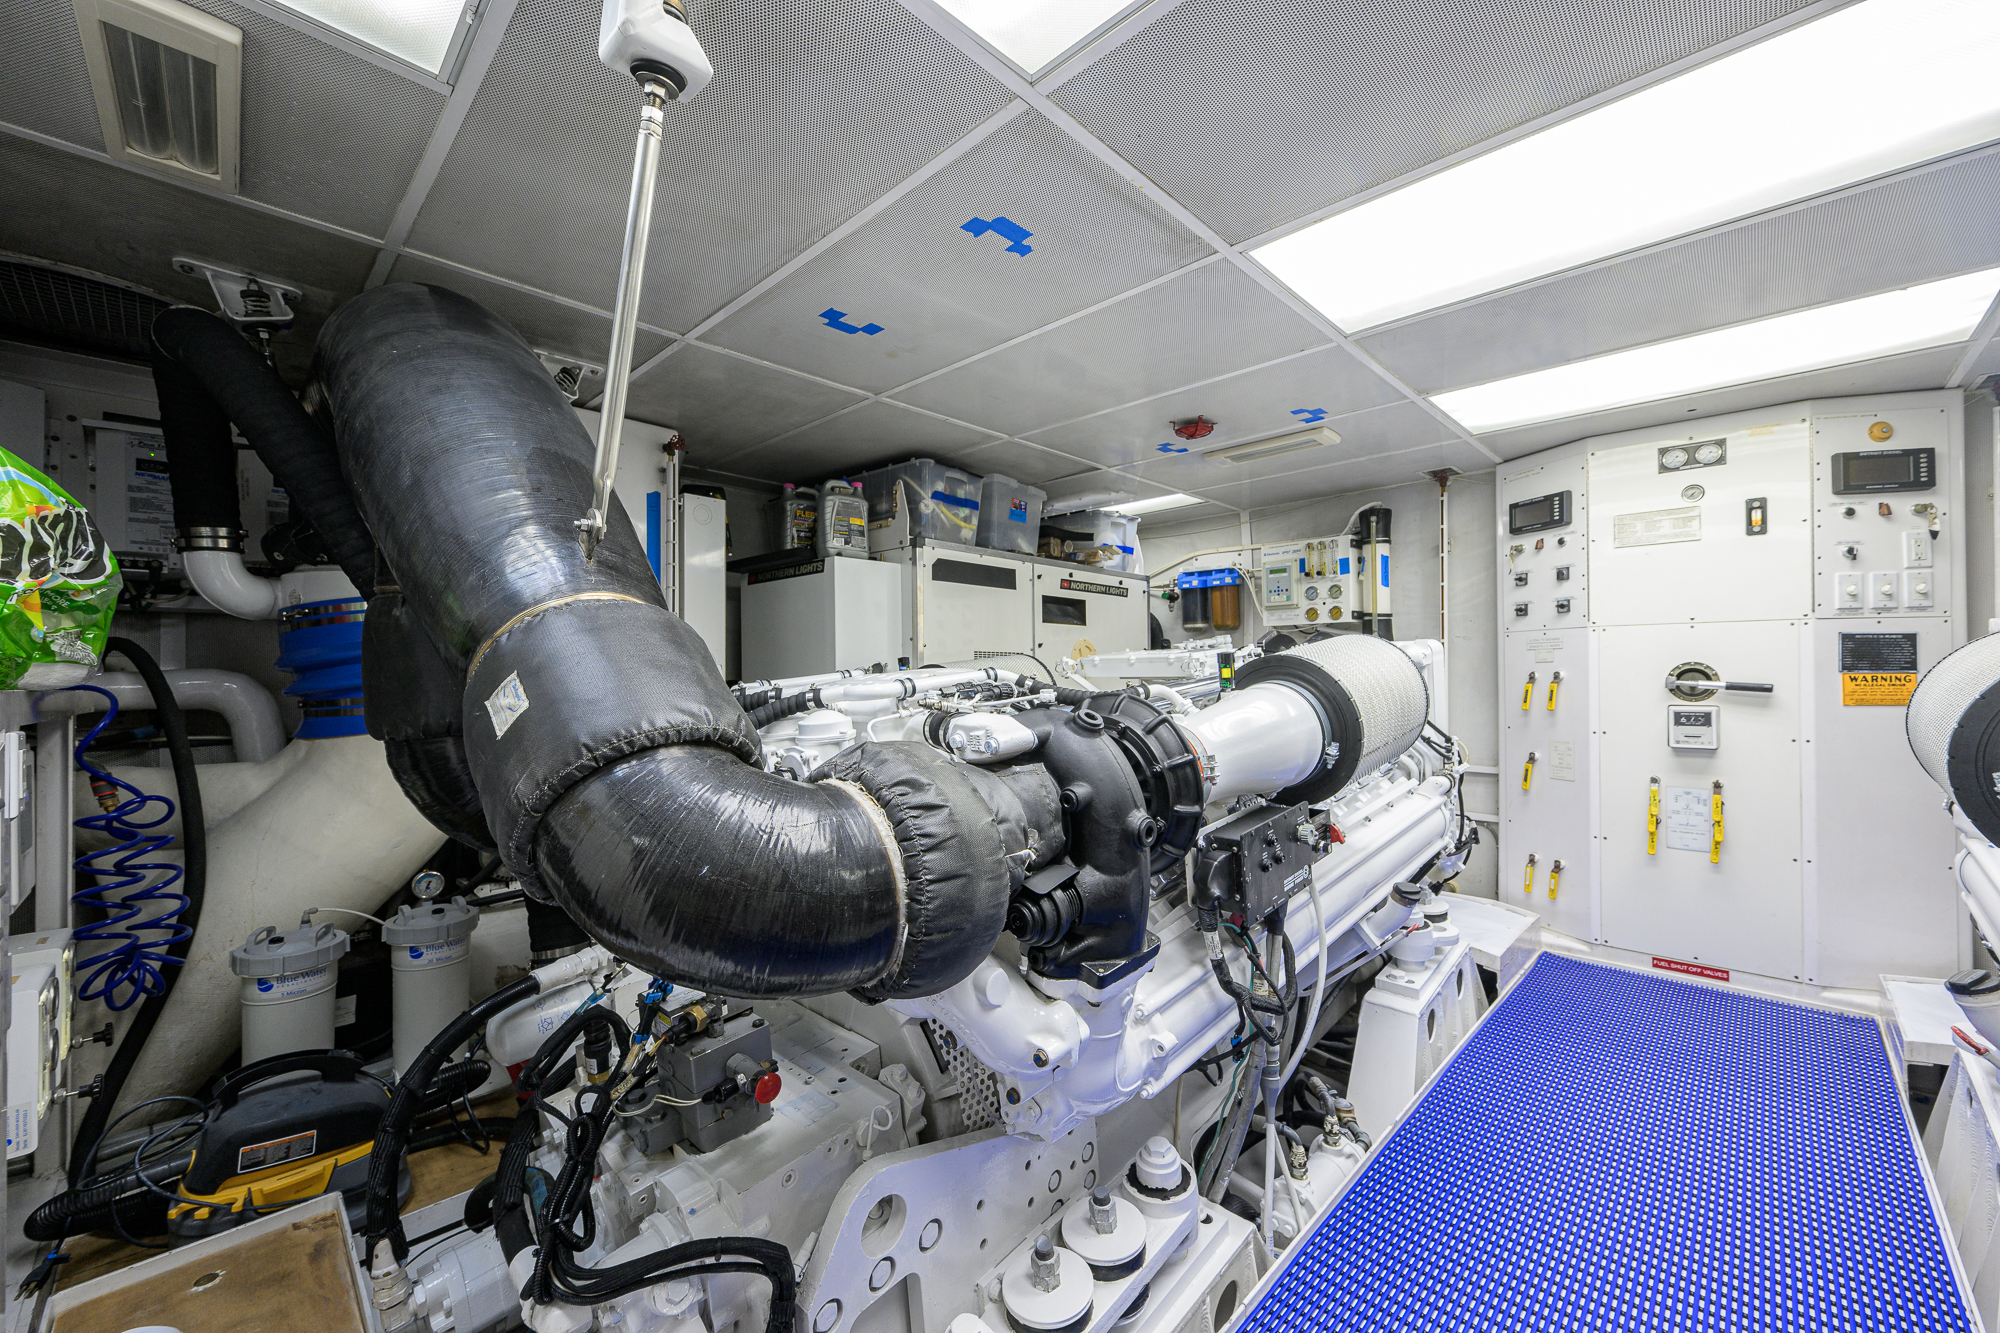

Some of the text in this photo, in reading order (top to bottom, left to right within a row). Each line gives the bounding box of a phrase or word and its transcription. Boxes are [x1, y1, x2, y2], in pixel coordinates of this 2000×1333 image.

[758, 561, 824, 580] NORTHERN LIGHTS
[1070, 582, 1128, 596] NORTHERN LIGHTS
[1848, 674, 1912, 683] WARNING
[426, 938, 466, 952] Blue Water
[276, 967, 328, 984] Blue Water
[1654, 960, 1669, 968] FUEL
[1702, 969, 1728, 978] VALVES
[286, 988, 308, 996] Micron
